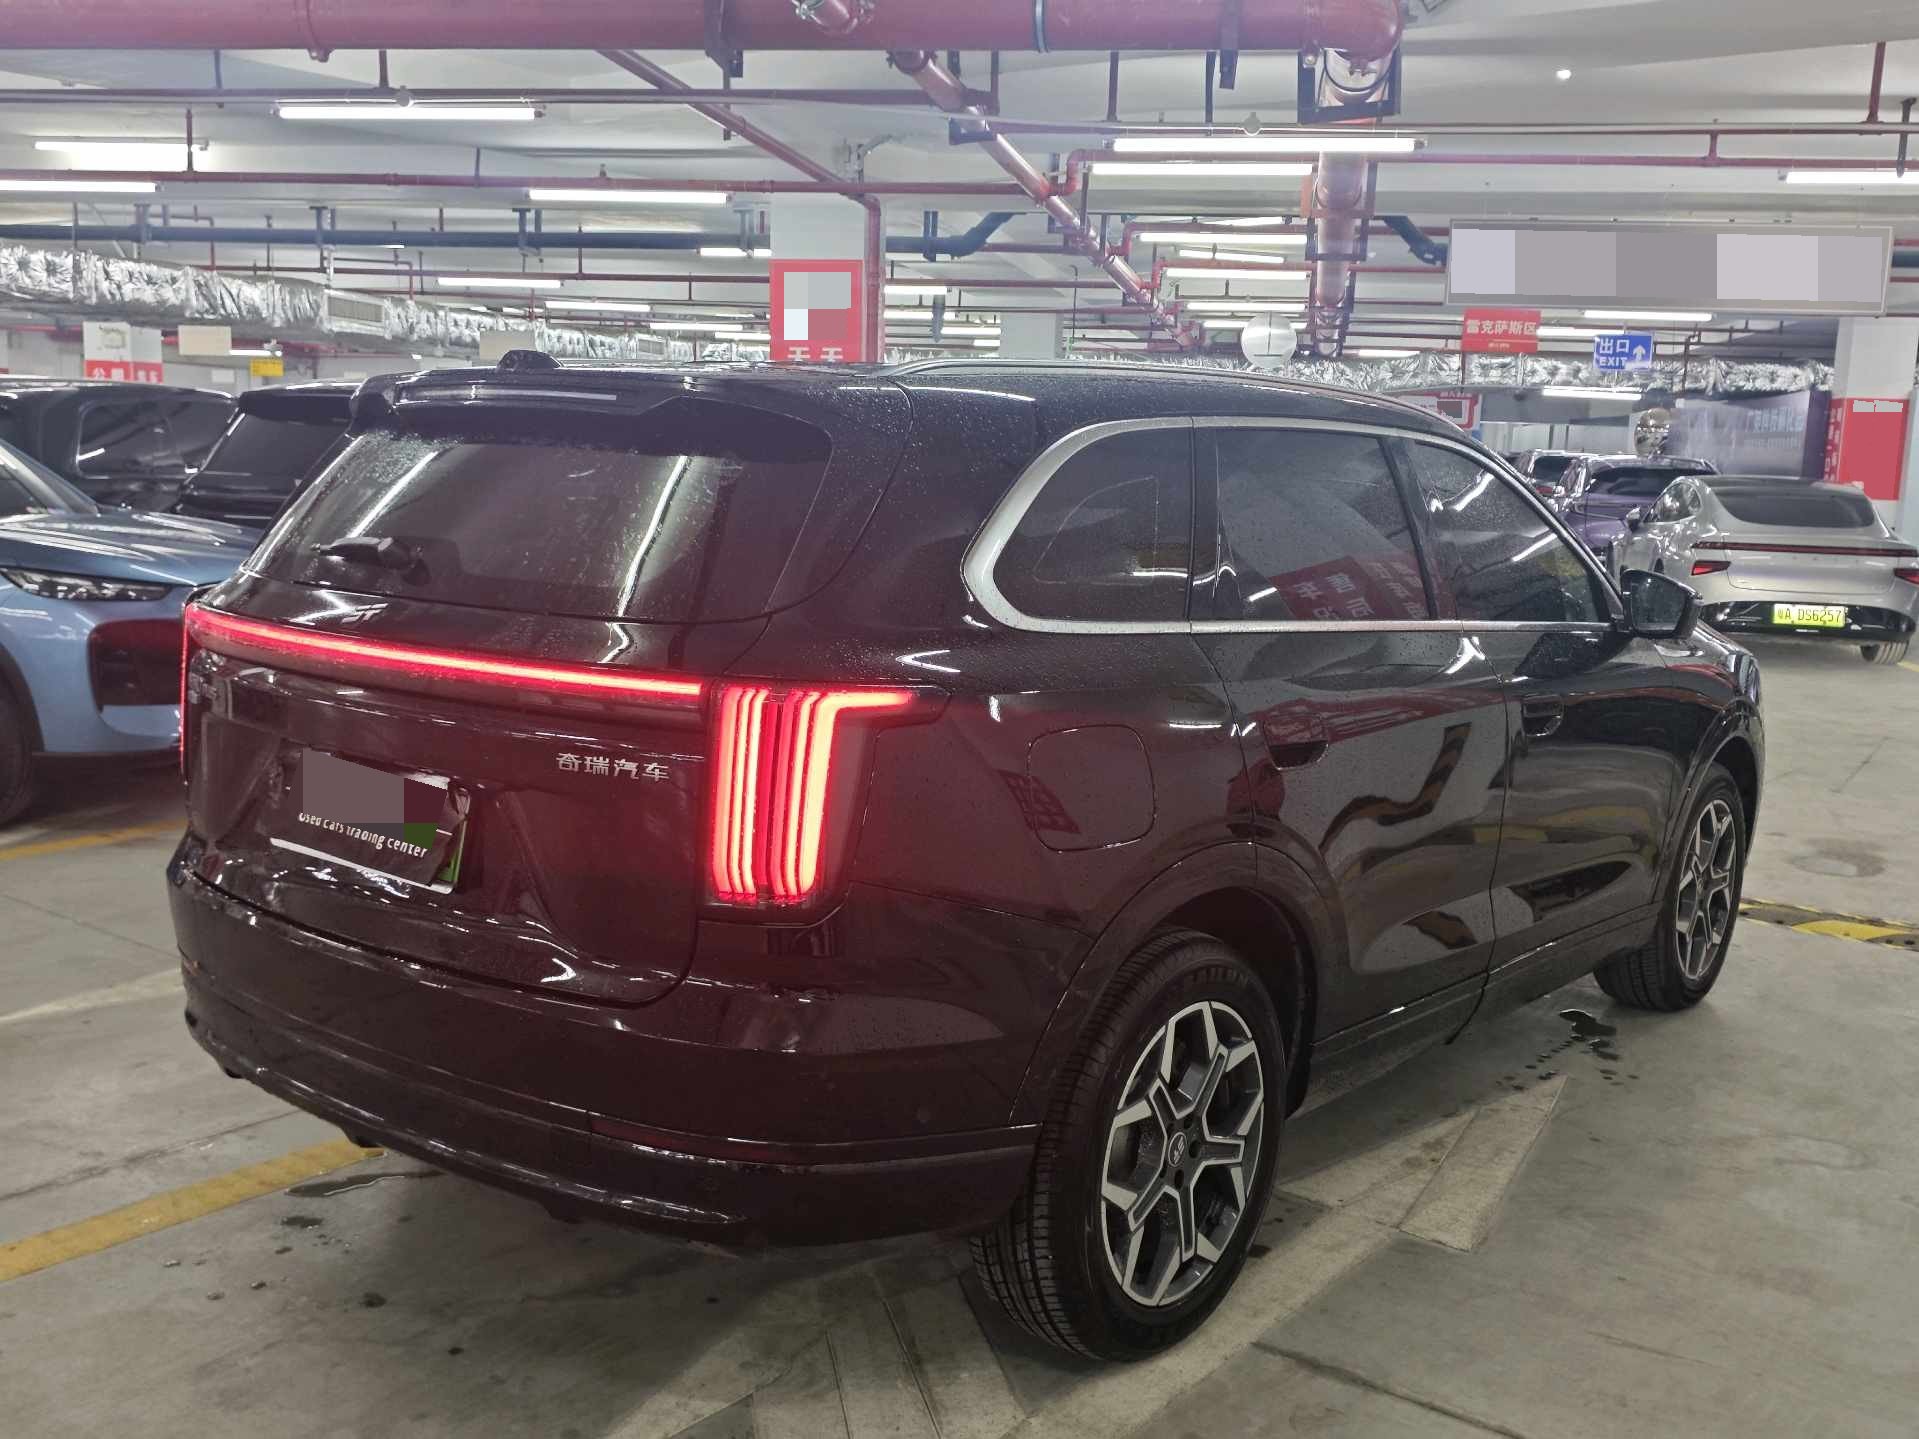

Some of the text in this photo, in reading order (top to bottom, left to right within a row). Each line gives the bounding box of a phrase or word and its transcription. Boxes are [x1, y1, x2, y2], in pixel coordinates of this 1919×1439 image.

[1599, 337, 1630, 355] 出口
[1599, 356, 1628, 368] EXIT
[556, 753, 669, 781] 奇瑞汽车
